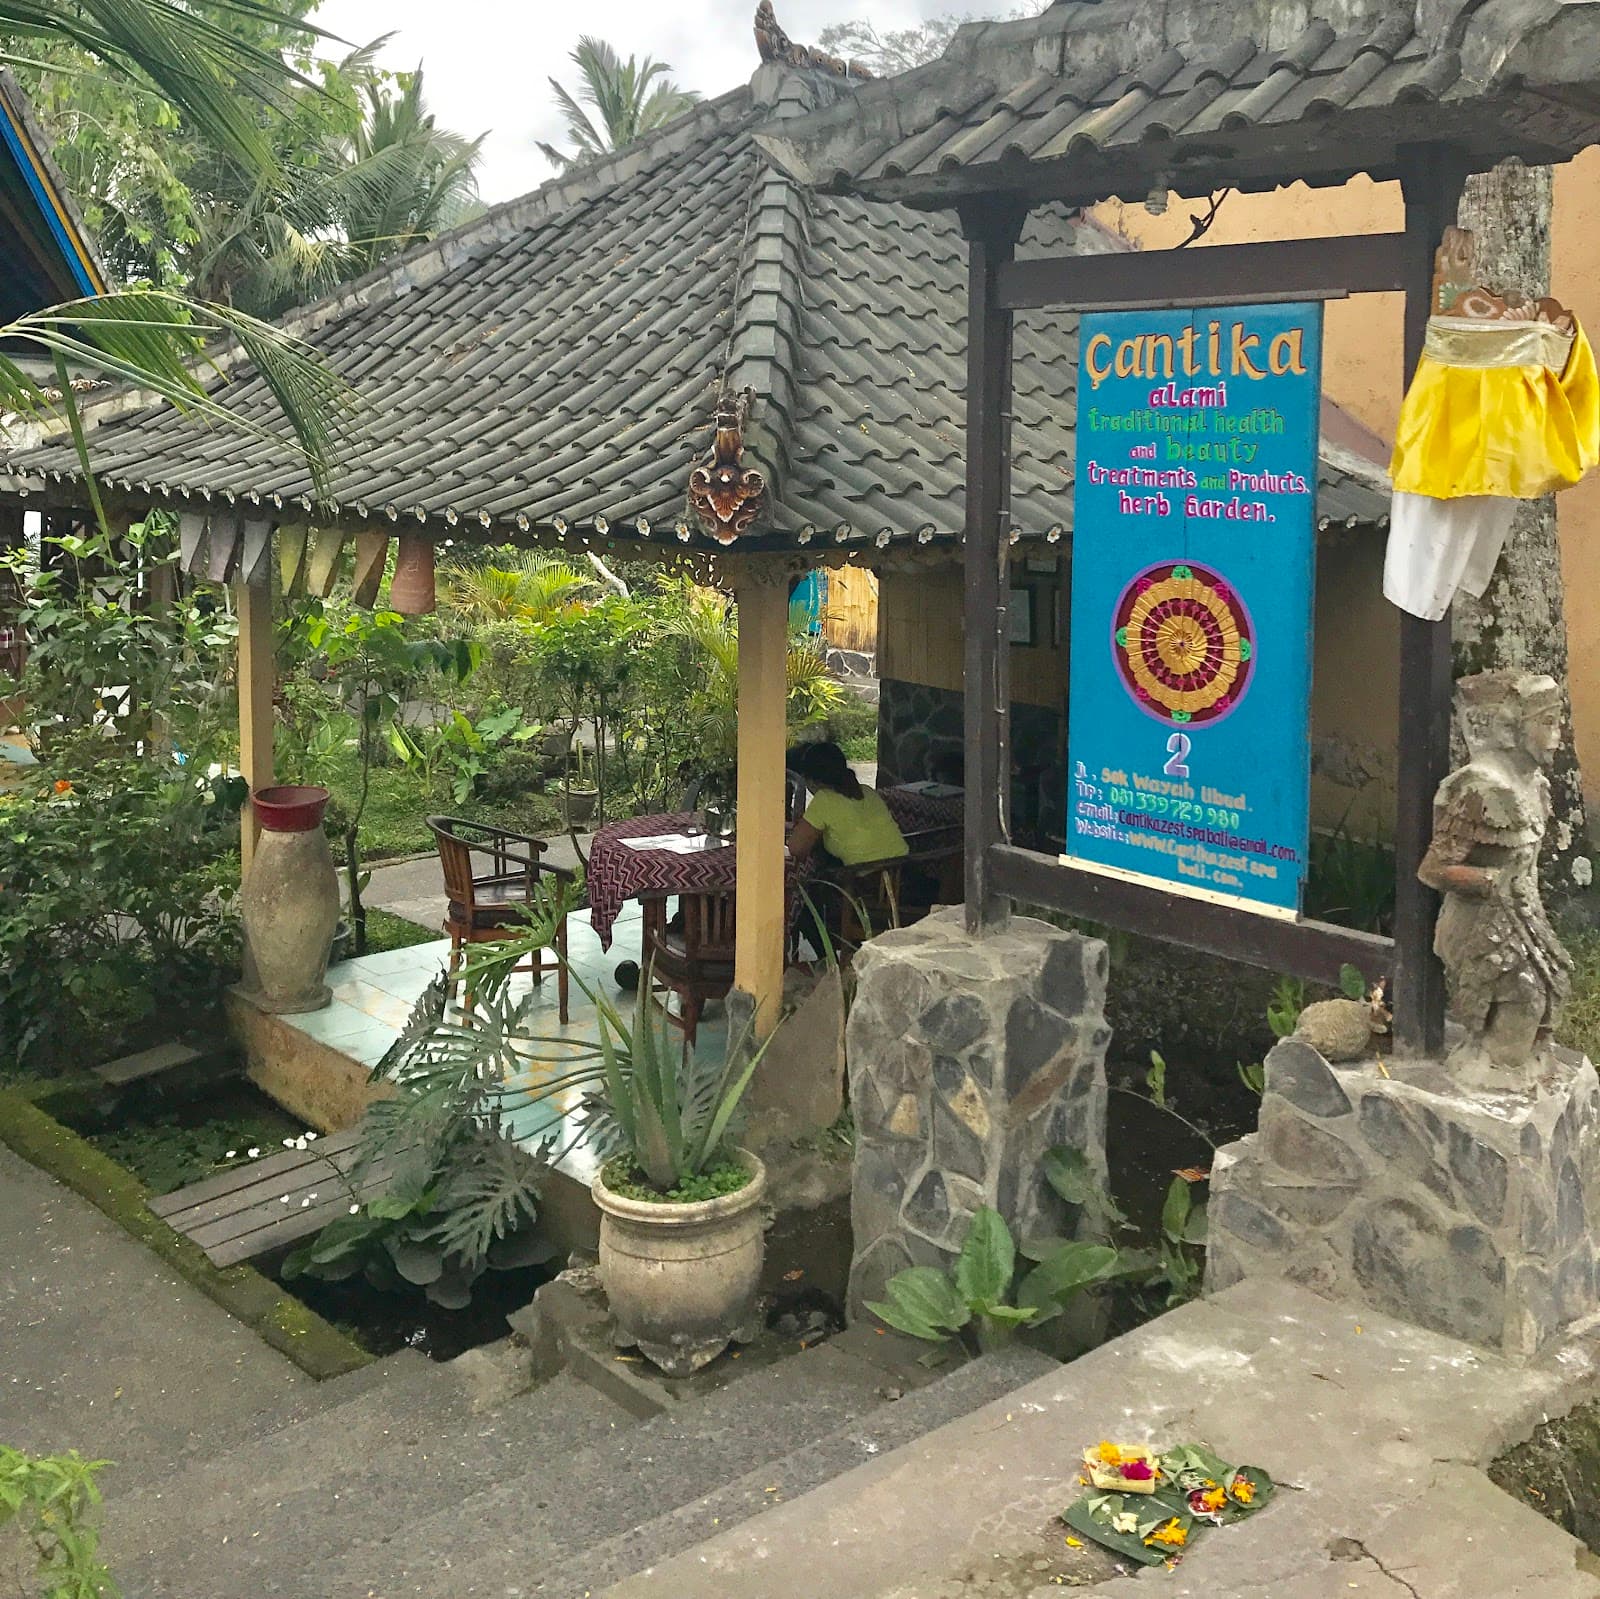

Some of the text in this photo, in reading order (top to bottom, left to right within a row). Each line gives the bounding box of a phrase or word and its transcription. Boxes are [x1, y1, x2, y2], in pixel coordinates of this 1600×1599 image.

[1088, 407, 1285, 433] traditional health
[1129, 435, 1258, 463] and beauty
[1088, 461, 1197, 489] treatments
[1200, 474, 1227, 490] and
[1118, 491, 1277, 522] herb Garden.
[1163, 732, 1191, 778] 2
